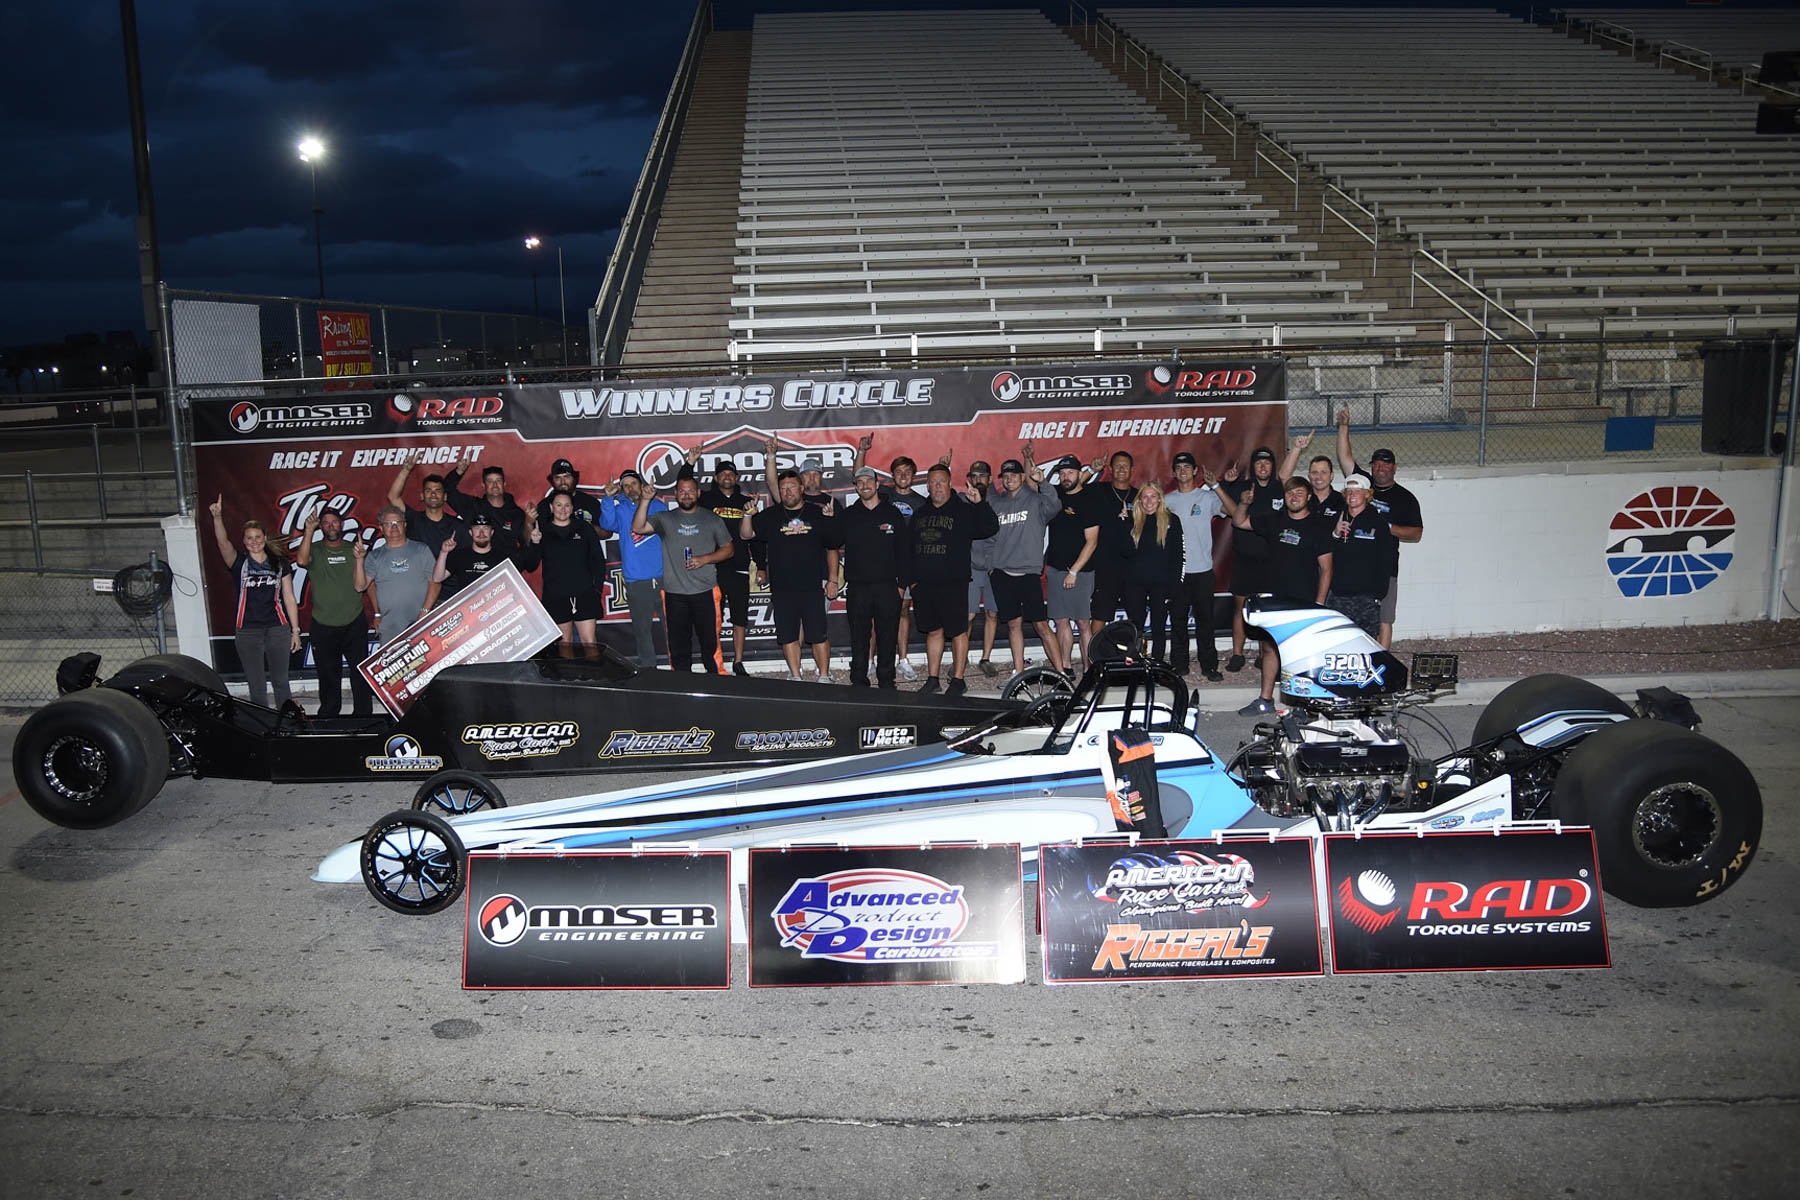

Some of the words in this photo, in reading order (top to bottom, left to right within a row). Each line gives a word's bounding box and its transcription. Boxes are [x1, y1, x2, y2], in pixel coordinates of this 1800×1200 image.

[1022, 375, 1132, 391] MOSER
[1176, 369, 1256, 390] RAD
[560, 384, 775, 419] WINNERS
[782, 378, 935, 411] CIRCLE
[1028, 390, 1125, 399] ENGINEERING
[259, 403, 372, 422] MOSER
[417, 397, 504, 418] RAD
[266, 420, 365, 429] ENGINEERING
[457, 416, 503, 425] SYSTEMS
[1018, 422, 1066, 440] RACE
[1068, 421, 1090, 439] IT
[1097, 417, 1203, 439] EXPERIENCE
[1204, 416, 1227, 434] IT
[269, 450, 318, 470] RACE
[320, 450, 343, 468] IT
[350, 446, 462, 468] EXPERIENCE
[693, 448, 854, 473] MOSER
[373, 658, 406, 686] SPRING
[403, 639, 430, 664] FLING
[465, 724, 575, 740] AMERICAN
[739, 728, 830, 748] BIONDO
[876, 727, 908, 738] Auto
[876, 735, 915, 747] Meter
[600, 729, 712, 757] RIGGEAL'S
[752, 743, 786, 751] RACING
[789, 740, 833, 750] PRODUCTS
[367, 756, 441, 766] MOSER
[1105, 863, 1255, 888] AMERICAN
[777, 881, 960, 914] Advanced
[1118, 886, 1171, 907] Race
[1120, 903, 1182, 917] Champions
[1184, 898, 1213, 911] Built
[1214, 894, 1249, 907] Here!
[1407, 879, 1592, 922] RAD
[528, 905, 717, 928] MOSER
[538, 931, 706, 942] ENGINEERING
[1407, 924, 1490, 937] TORQUE
[1492, 921, 1592, 935] SYSTEMS
[806, 926, 951, 955] Design
[1092, 918, 1274, 971] RIGGEAL'S
[1129, 960, 1180, 968] PERFORMANCE
